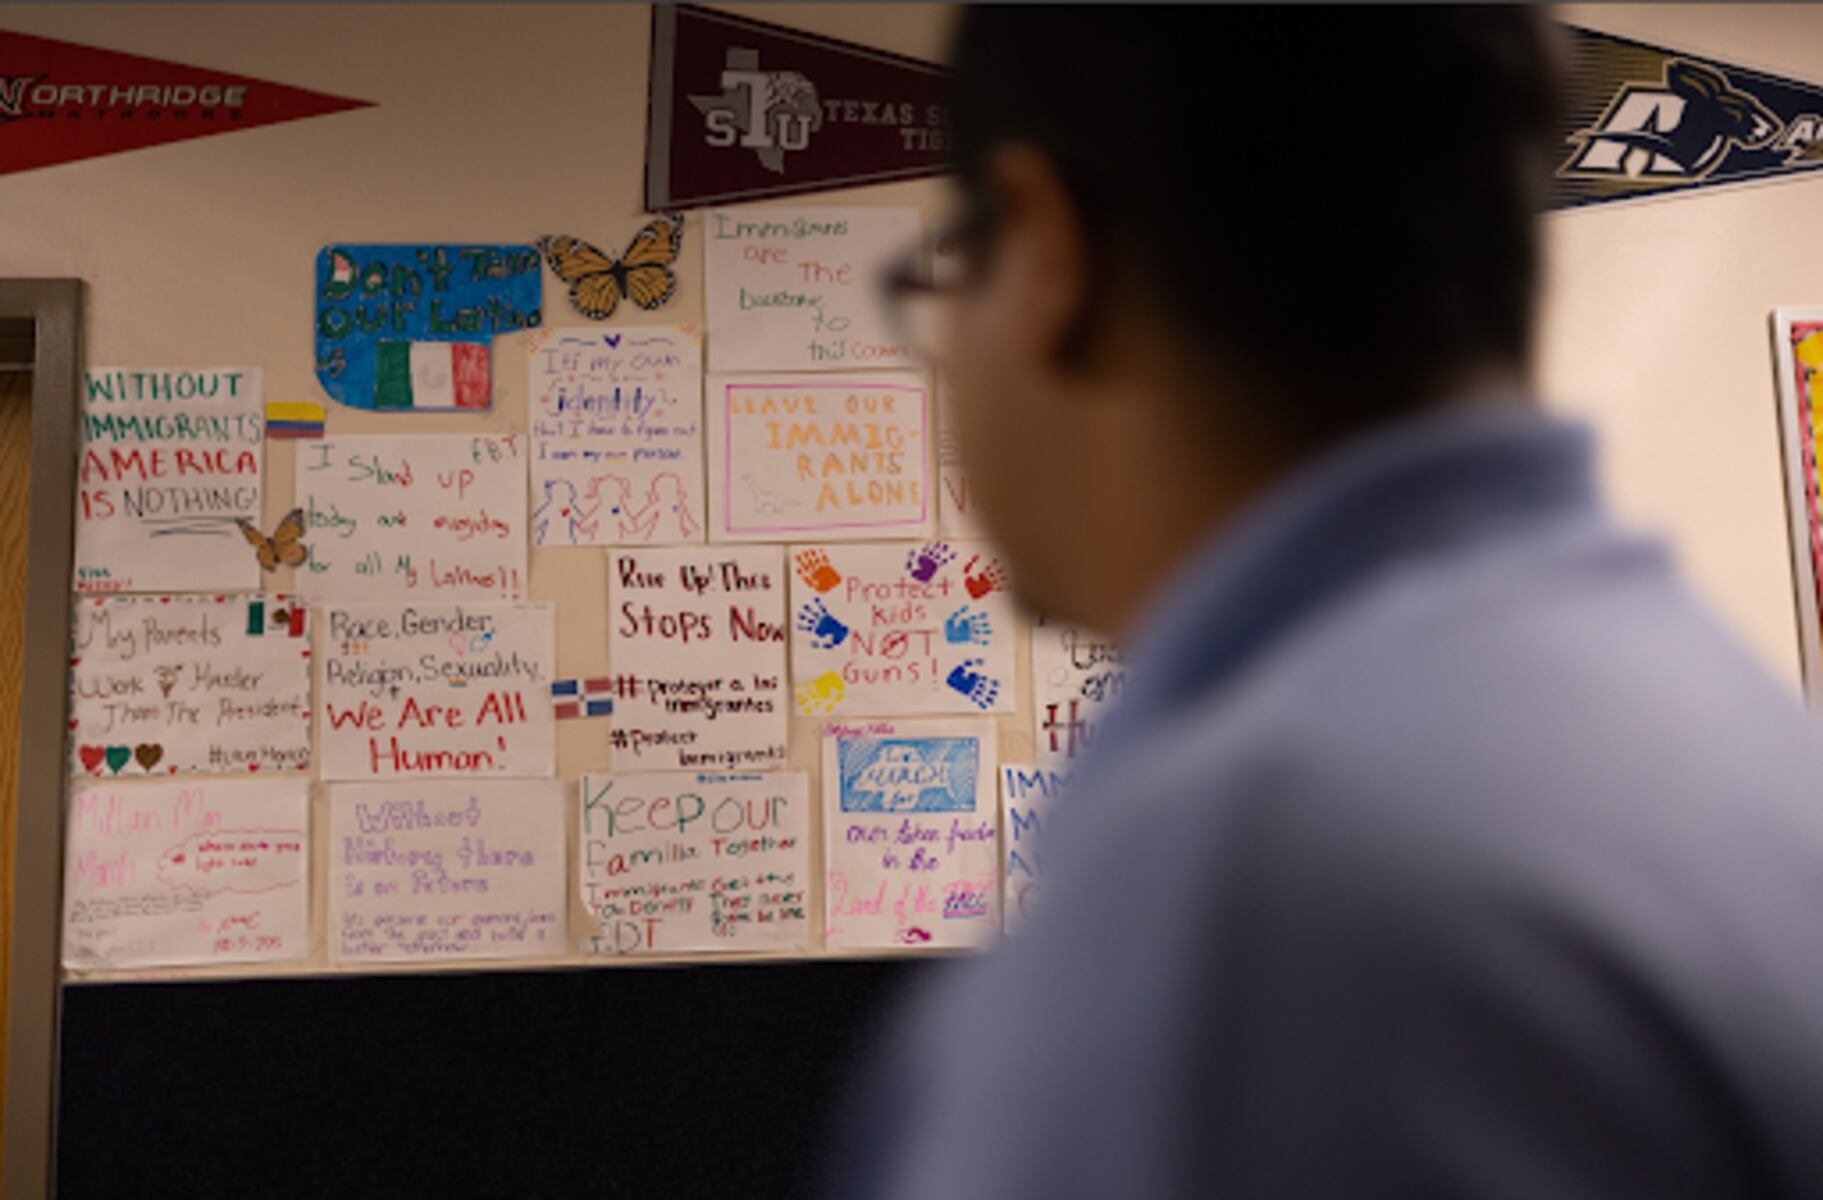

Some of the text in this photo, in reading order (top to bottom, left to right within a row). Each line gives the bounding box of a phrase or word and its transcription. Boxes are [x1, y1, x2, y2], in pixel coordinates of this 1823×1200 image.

[823, 98, 915, 126] TEXAS
[84, 371, 242, 402] WITHOUT
[844, 395, 895, 414] OUR
[81, 410, 261, 445] IMMIGRANTS
[82, 449, 257, 483] AMERICA
[307, 444, 335, 470] I
[796, 452, 904, 481] RANTS
[81, 490, 115, 520] IS
[846, 576, 955, 602] Protect
[78, 609, 221, 660] My Parents
[620, 602, 711, 643] Stops
[851, 629, 939, 660] NOT
[78, 676, 143, 699] Work
[327, 691, 527, 730] We Are All
[370, 736, 507, 773] Human!
[583, 776, 705, 837] Keep
